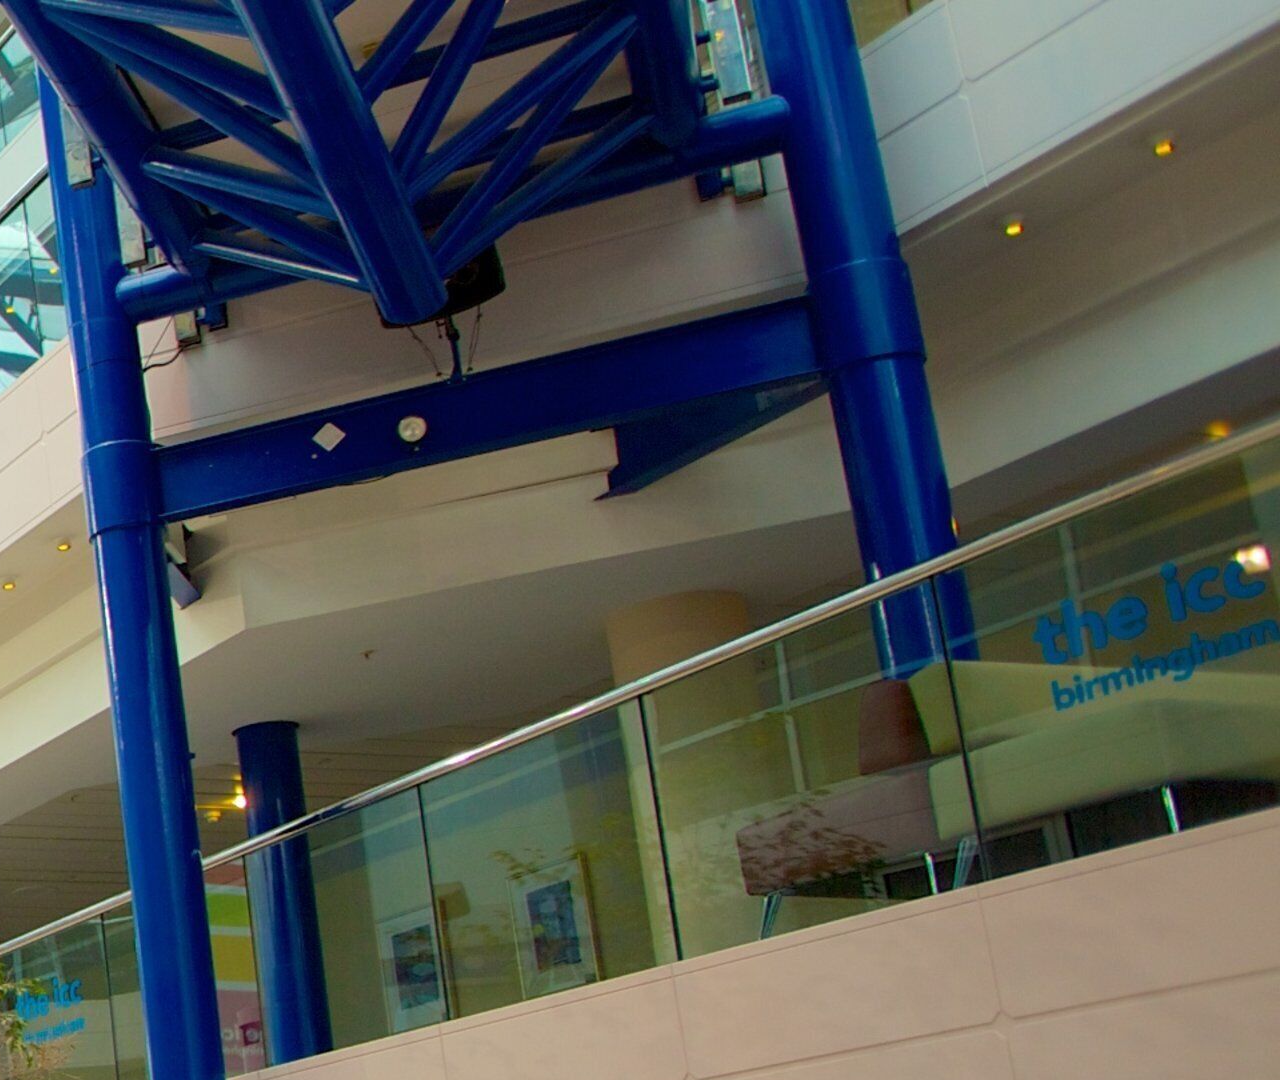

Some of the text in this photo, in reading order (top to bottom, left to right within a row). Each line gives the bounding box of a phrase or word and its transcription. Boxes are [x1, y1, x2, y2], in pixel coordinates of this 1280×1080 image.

[1031, 560, 1266, 665] the icc
[1051, 618, 1280, 711] birmingham
